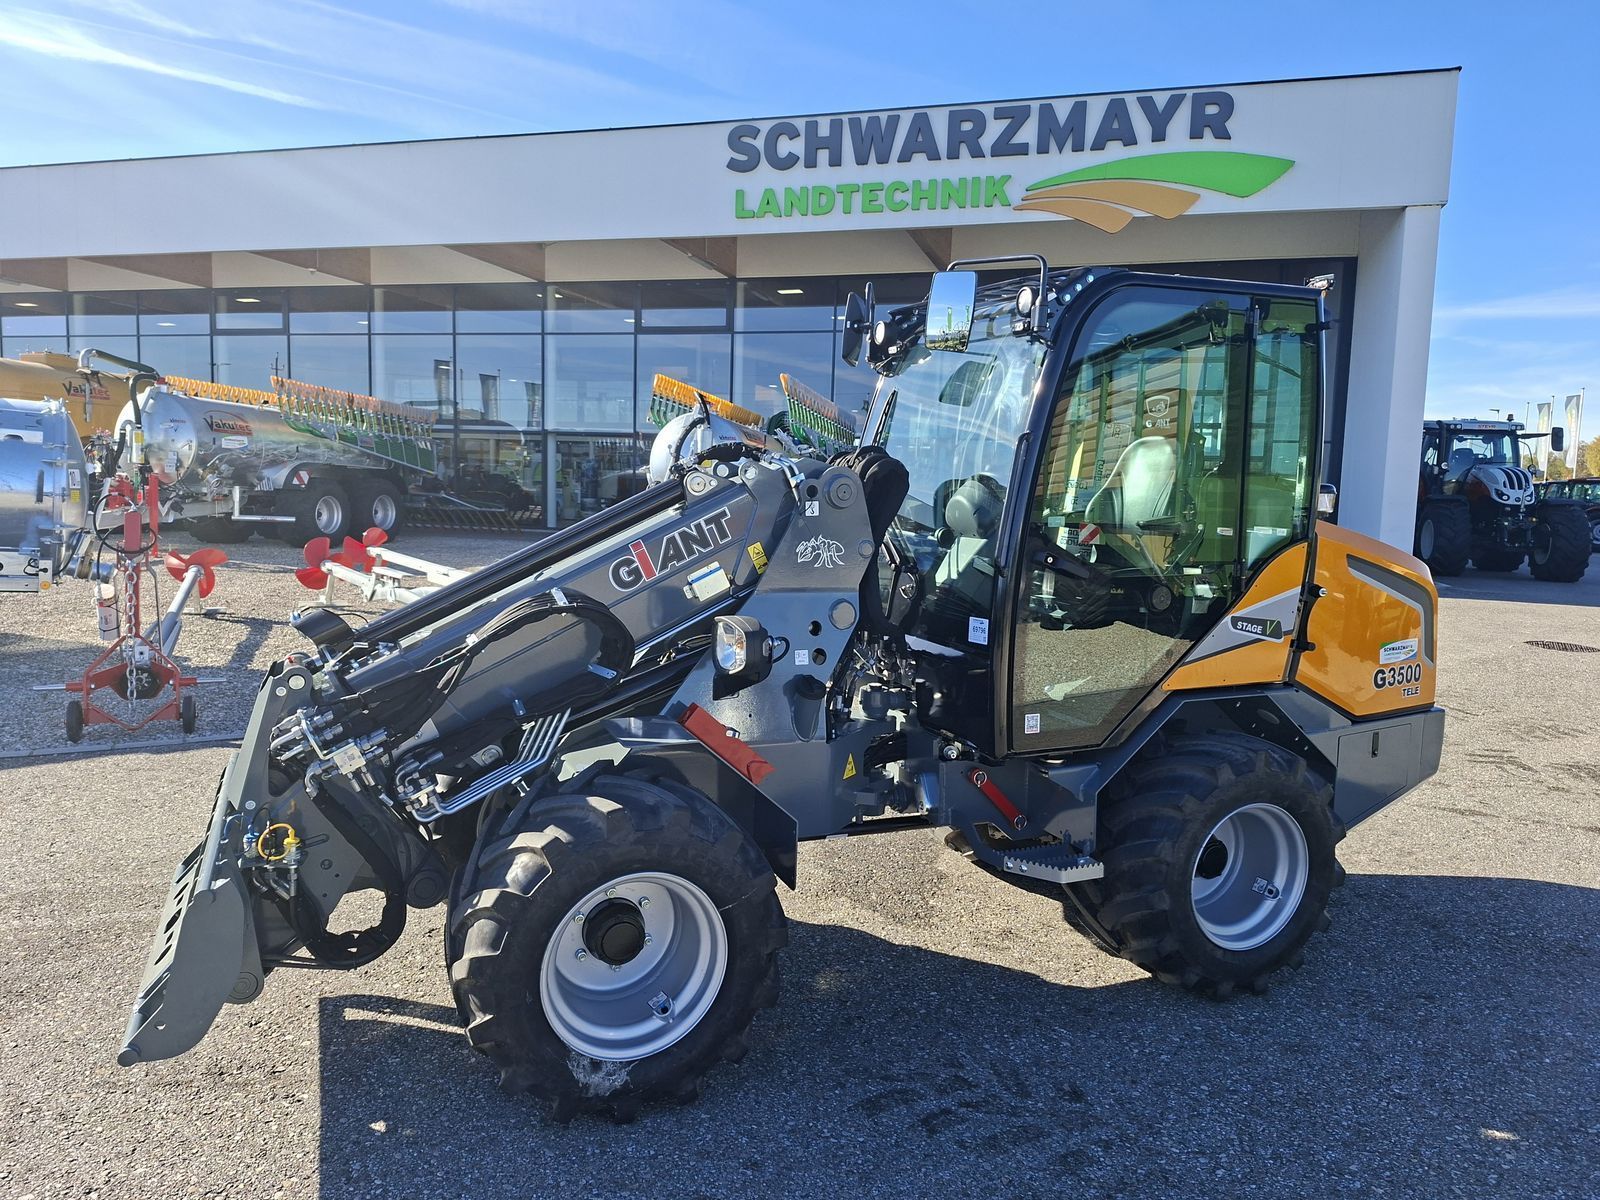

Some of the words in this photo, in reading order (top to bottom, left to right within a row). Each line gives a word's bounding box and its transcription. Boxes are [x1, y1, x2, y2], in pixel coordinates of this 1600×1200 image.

[726, 91, 1235, 173] SCHWARZMAYR
[735, 175, 1012, 219] LANDTECHNIK
[203, 415, 252, 432] Vakutec
[1236, 621, 1263, 634] STAGE
[1266, 618, 1279, 635] V
[1373, 662, 1422, 691] G3500
[1402, 686, 1420, 697] TELE
